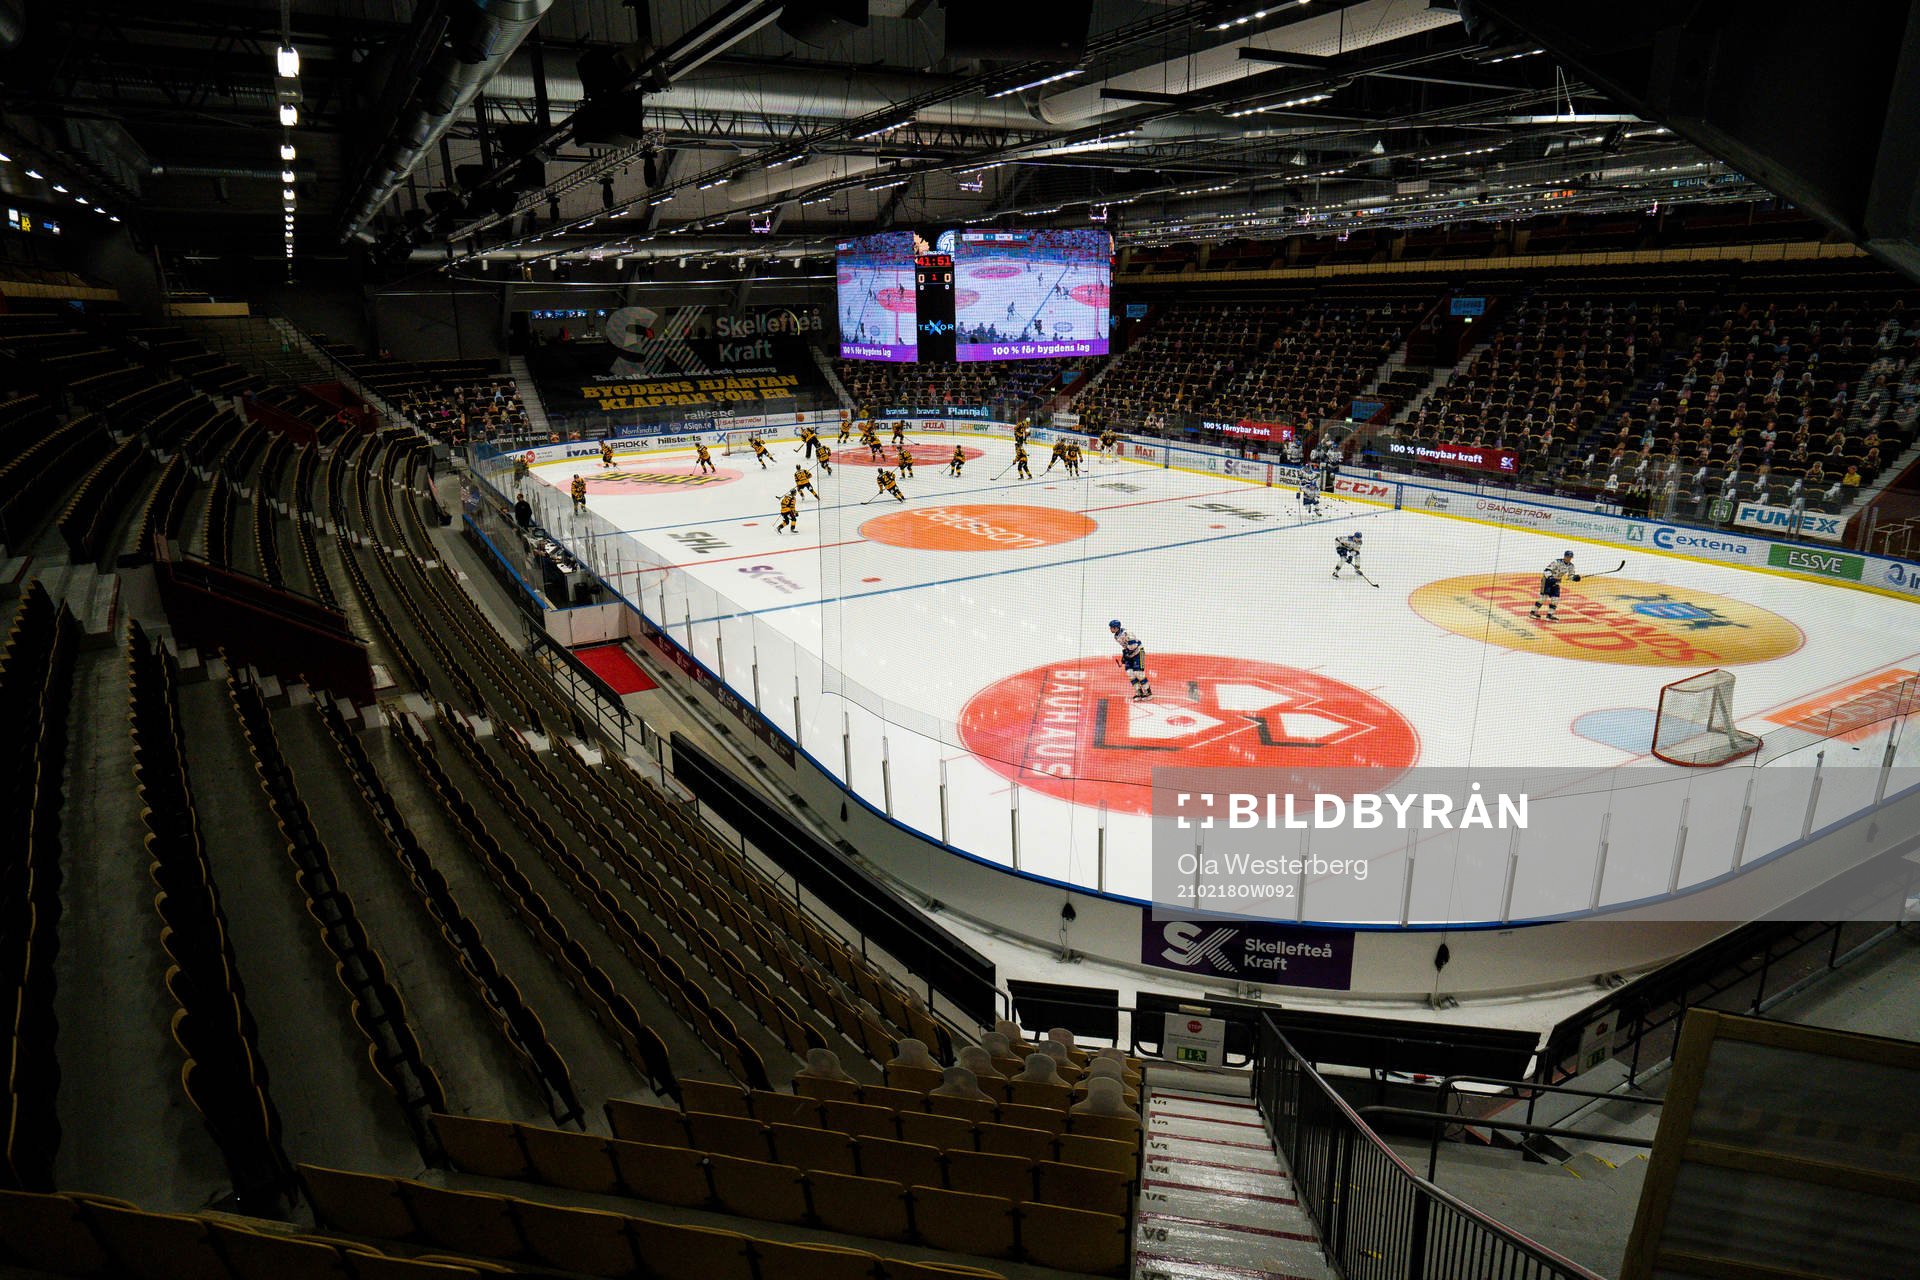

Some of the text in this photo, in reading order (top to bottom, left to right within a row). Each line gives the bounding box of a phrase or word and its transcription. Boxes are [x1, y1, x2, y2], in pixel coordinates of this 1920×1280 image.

[917, 256, 951, 267] 41:51
[716, 308, 822, 338] Skellefteå
[918, 319, 954, 336] TEXOR
[719, 340, 773, 363] Kraft
[882, 348, 892, 358] lag
[992, 343, 1090, 356] 100 % för bygdens lag
[581, 375, 799, 398] BYGDENS HJÄRTAN
[599, 391, 709, 411] KLAPPAR
[711, 388, 759, 403] FÖR
[947, 407, 980, 417] Plannja
[923, 421, 945, 431] JULA
[1203, 421, 1216, 430] 100
[1222, 424, 1252, 435] förnybar
[1253, 427, 1271, 437] kraft
[610, 440, 649, 449] BROKK
[657, 434, 702, 444] hillstedts
[566, 448, 600, 458] IVAB
[1390, 444, 1483, 464] 100 % förnybar kraft
[1335, 479, 1389, 497] CCM
[1740, 507, 1840, 534] FUMEX
[1676, 535, 1748, 555] extena
[1788, 551, 1844, 573] ESSVE
[1032, 670, 1086, 777] BAUHAUS
[1161, 921, 1238, 973] SK
[1244, 937, 1333, 958] Skellefteå
[1243, 954, 1288, 971] Kraft
[1150, 1141, 1168, 1150] V3
[1145, 1191, 1168, 1202] V5
[1142, 1226, 1169, 1243] V6
